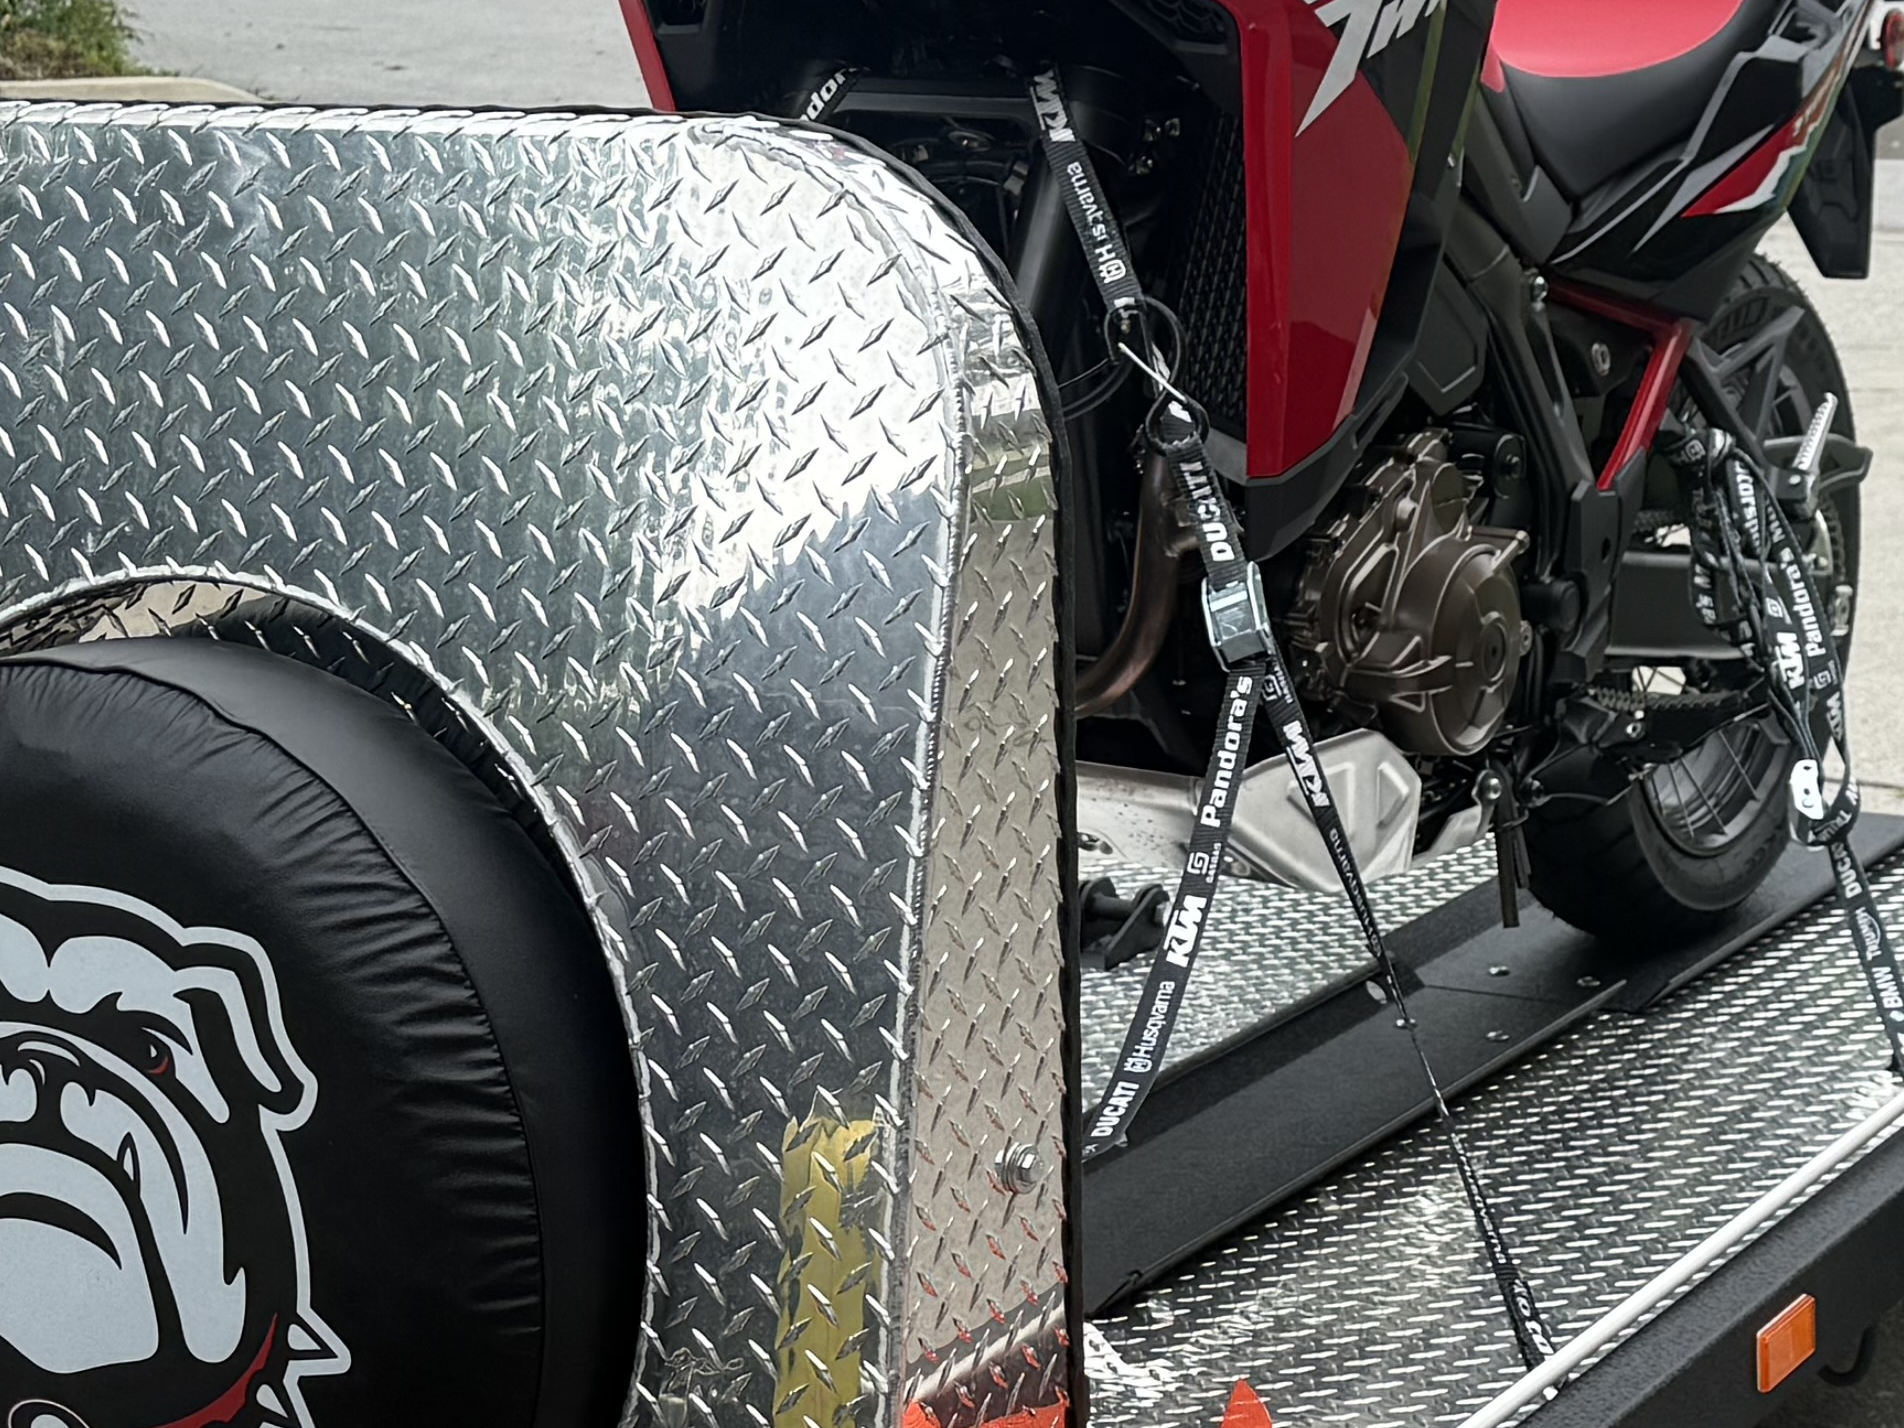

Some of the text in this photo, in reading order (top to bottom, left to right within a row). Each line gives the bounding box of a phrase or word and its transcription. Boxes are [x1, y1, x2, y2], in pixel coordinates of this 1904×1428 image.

[1029, 70, 1077, 143] KTM
[1780, 547, 1827, 657] Pandora's
[1775, 632, 1805, 690] KTM
[1200, 676, 1253, 828] Pandora's
[1283, 720, 1330, 807] KTM
[1831, 842, 1863, 899] DUCA
[1163, 895, 1207, 968] KTM
[1132, 980, 1176, 1059] Husqvarna
[1871, 966, 1904, 1009] BMW
[1090, 1081, 1140, 1137] DUCATI
